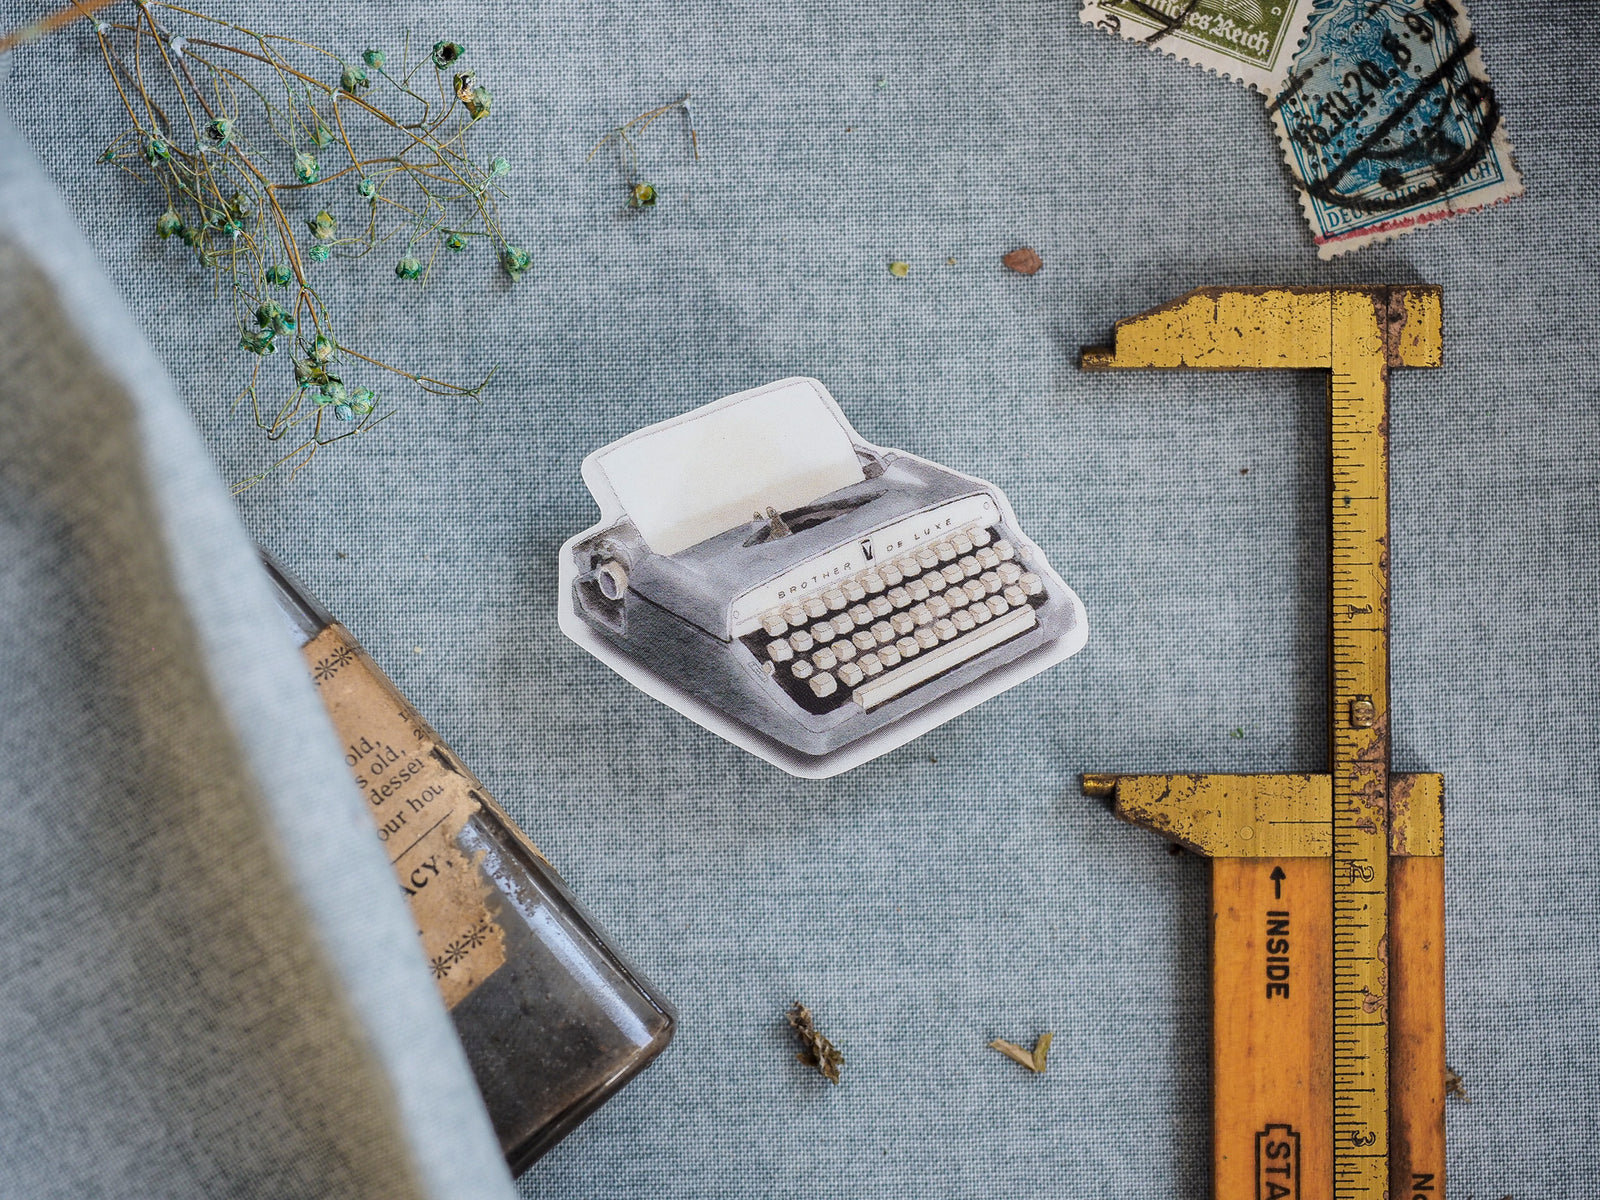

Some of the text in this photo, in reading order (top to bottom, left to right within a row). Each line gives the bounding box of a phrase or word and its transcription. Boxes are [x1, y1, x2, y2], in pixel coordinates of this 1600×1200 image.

[1209, 13, 1271, 55] Reich
[1326, 181, 1430, 229] DEUSCHES
[777, 562, 852, 599] BROTHER
[914, 518, 952, 540] LUXE
[1348, 603, 1373, 620] 1
[344, 737, 382, 767] old,
[370, 745, 407, 776] old,
[413, 728, 425, 741] 2
[1349, 864, 1375, 883] 2
[1266, 911, 1290, 1000] INSIDE
[1351, 1130, 1376, 1148] 3
[1265, 1140, 1292, 1200] STA
